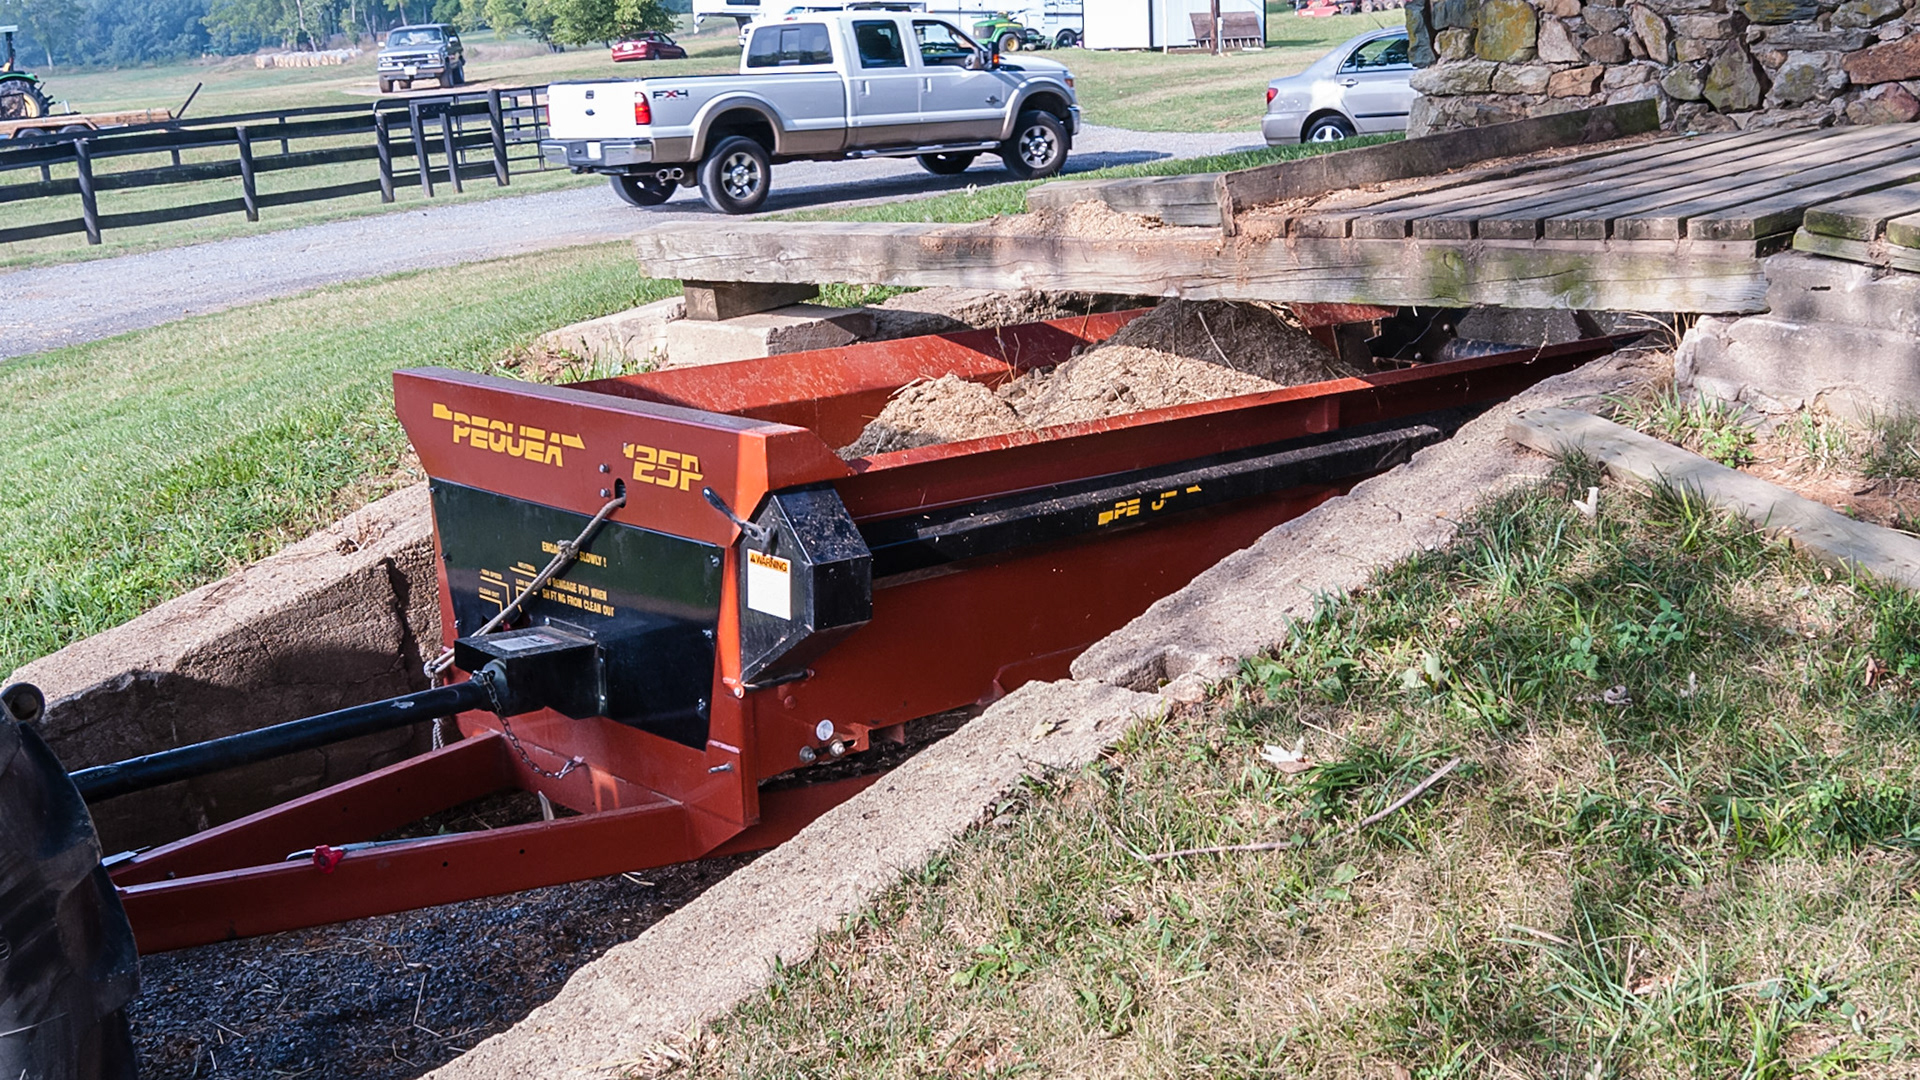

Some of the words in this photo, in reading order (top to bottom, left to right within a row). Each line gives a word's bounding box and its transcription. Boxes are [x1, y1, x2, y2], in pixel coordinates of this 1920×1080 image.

[652, 90, 689, 99] FX4
[451, 412, 564, 467] PEQUEA
[756, 554, 788, 573] WARNING
[567, 595, 583, 609] FROM
[583, 599, 602, 614] CLEAN
[602, 604, 615, 618] OUT
